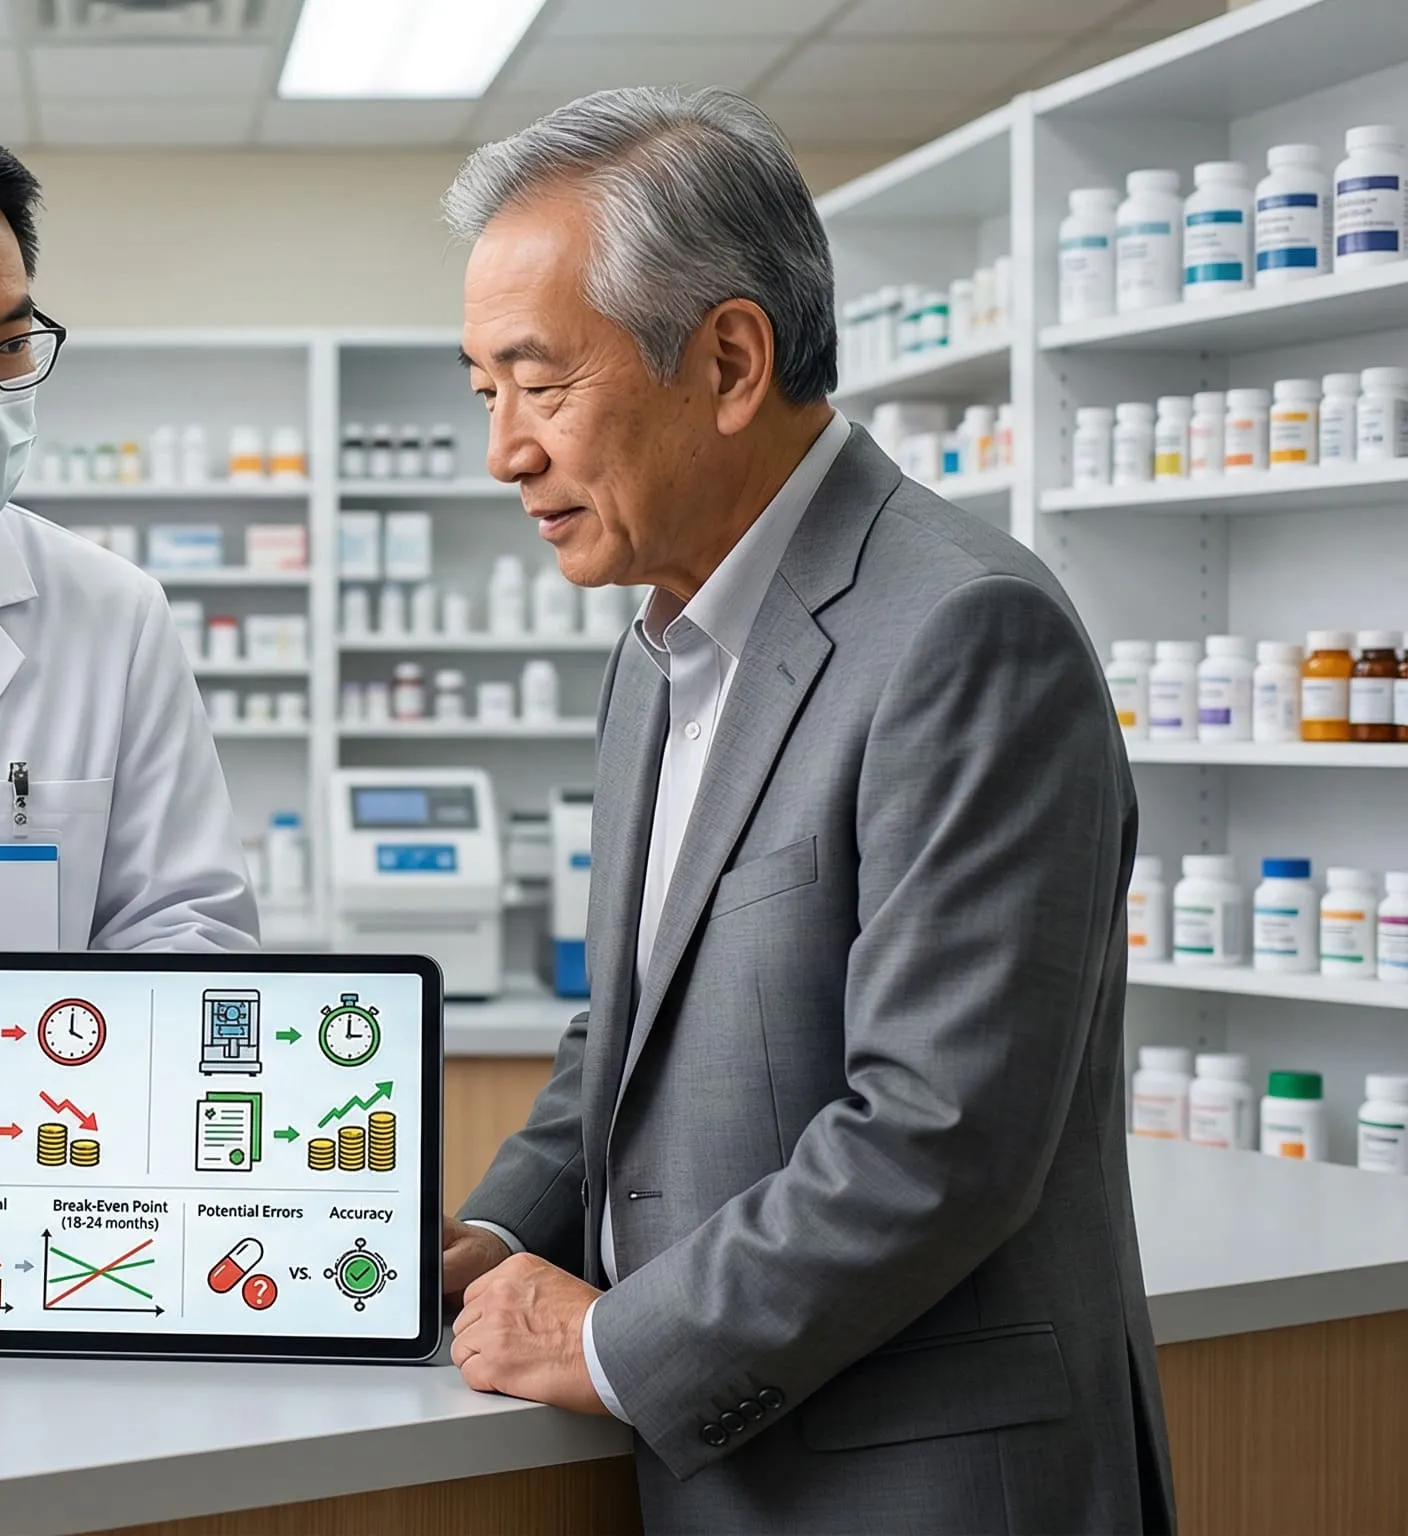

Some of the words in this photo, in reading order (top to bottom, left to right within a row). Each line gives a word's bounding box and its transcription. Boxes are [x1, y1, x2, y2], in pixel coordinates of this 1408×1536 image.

[53, 1199, 129, 1213] Break-Even
[133, 1200, 168, 1213] Point
[197, 1204, 259, 1218] Potential
[262, 1205, 303, 1218] Errors
[329, 1206, 393, 1223] Accuracy
[61, 1216, 102, 1230] (18-24
[105, 1217, 159, 1231] months)
